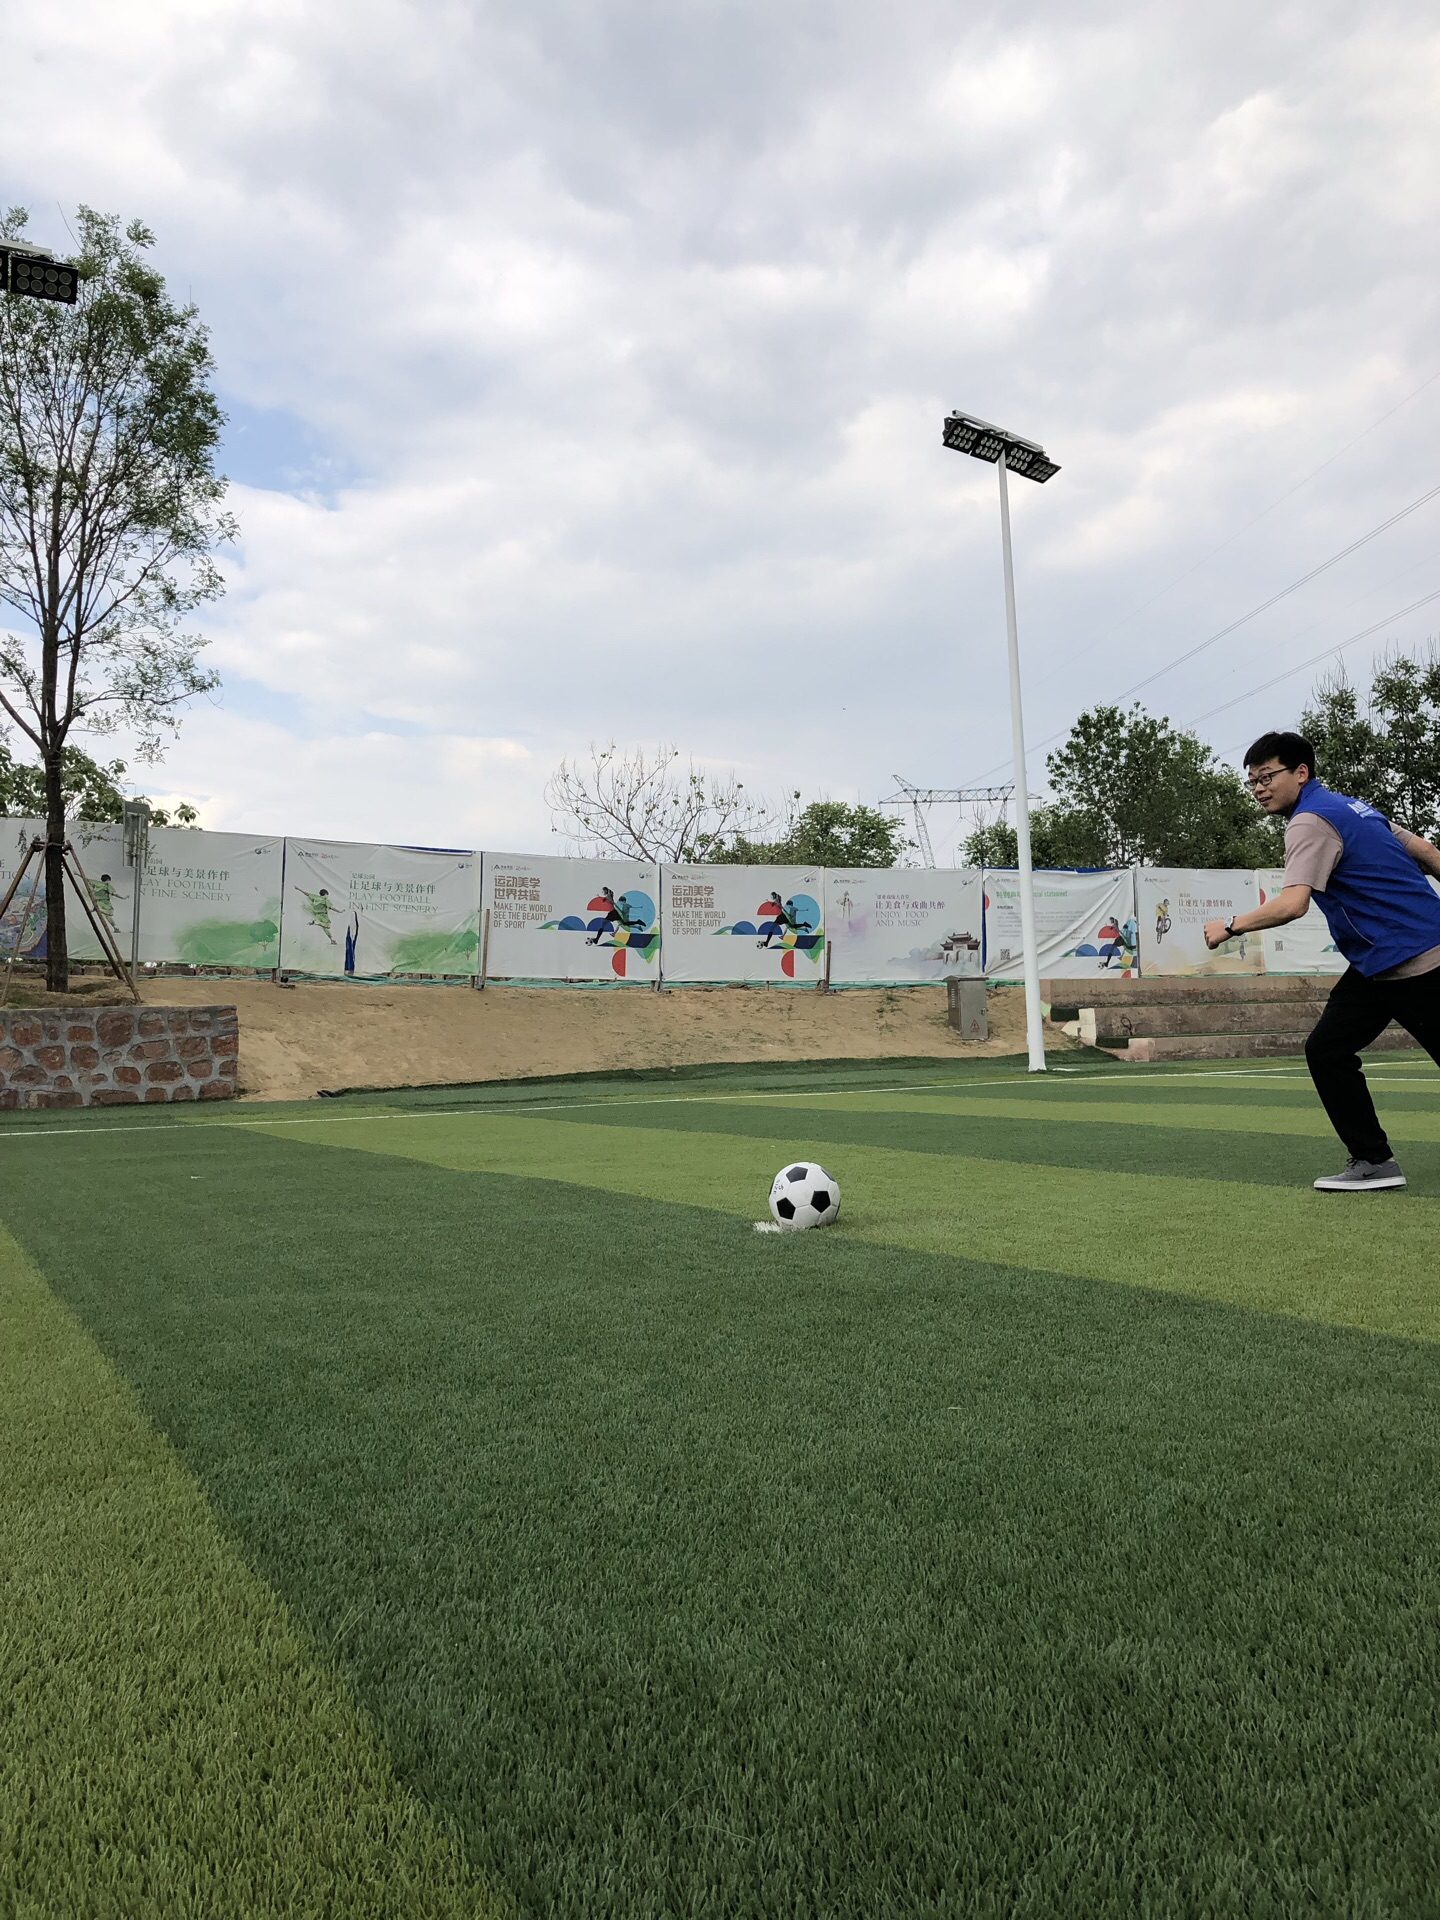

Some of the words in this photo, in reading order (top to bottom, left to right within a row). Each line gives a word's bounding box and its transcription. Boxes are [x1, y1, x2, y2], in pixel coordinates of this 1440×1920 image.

[140, 878, 161, 887] LAY
[167, 879, 224, 891] FOOTBALL
[349, 879, 436, 895] 让足球与美景作伴
[494, 875, 540, 888] 运动美学
[152, 889, 177, 899] FINE
[182, 891, 233, 902] SCENERY
[494, 888, 540, 901] 世界共鉴
[672, 885, 714, 897] 运动美学
[349, 891, 375, 902] PLAY
[380, 893, 431, 904] FOOTBALL
[672, 897, 714, 909] 世界共鉴
[365, 903, 389, 912] FINE
[393, 904, 439, 914] SCENERY
[494, 901, 513, 911] MAKE
[515, 903, 527, 912] THE
[529, 904, 553, 913] WORLD
[875, 900, 945, 910] 让美食与戏曲共醉
[494, 911, 507, 920] SEE
[508, 911, 521, 921] THE
[522, 912, 547, 921] BEAUTY
[672, 910, 690, 919] MAKE
[691, 910, 703, 919] THE
[704, 910, 726, 919] WORLD
[875, 911, 901, 919] ENJOY
[1178, 908, 1209, 916] UNLEASH
[494, 920, 503, 928] OF
[504, 920, 526, 929] SPORT
[672, 919, 684, 927] SEE
[685, 919, 697, 927] THE
[698, 919, 721, 927] BEAUTY
[1179, 916, 1198, 924] YOUR
[672, 927, 681, 936] OF
[682, 927, 702, 936] SPORT
